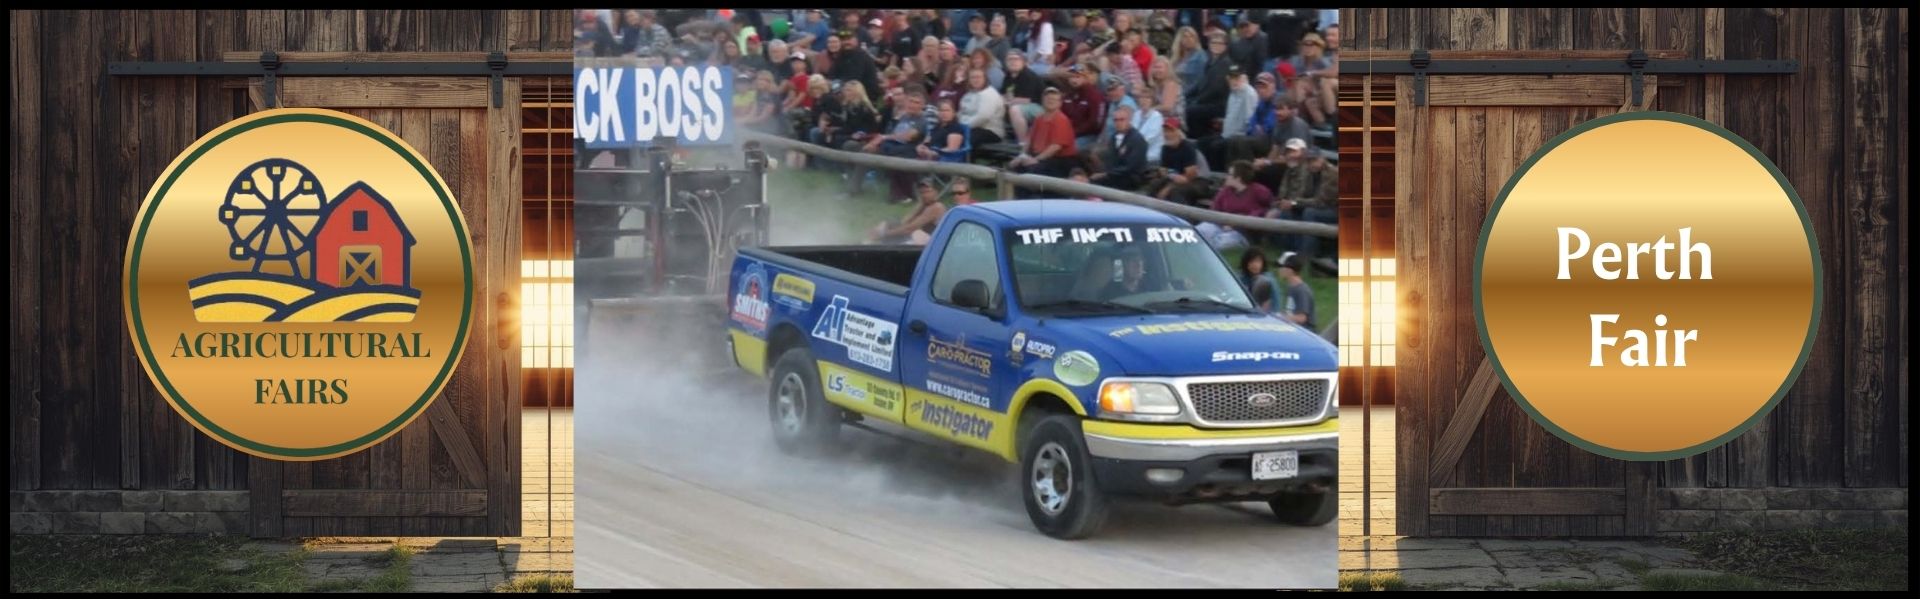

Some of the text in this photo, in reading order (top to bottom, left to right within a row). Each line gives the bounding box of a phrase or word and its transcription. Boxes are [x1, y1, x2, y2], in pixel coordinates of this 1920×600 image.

[574, 66, 724, 143] CK BOSS
[847, 313, 875, 328] Advantage
[865, 331, 876, 340] and
[1211, 350, 1300, 362] Snap-on
[828, 374, 844, 392] LS
